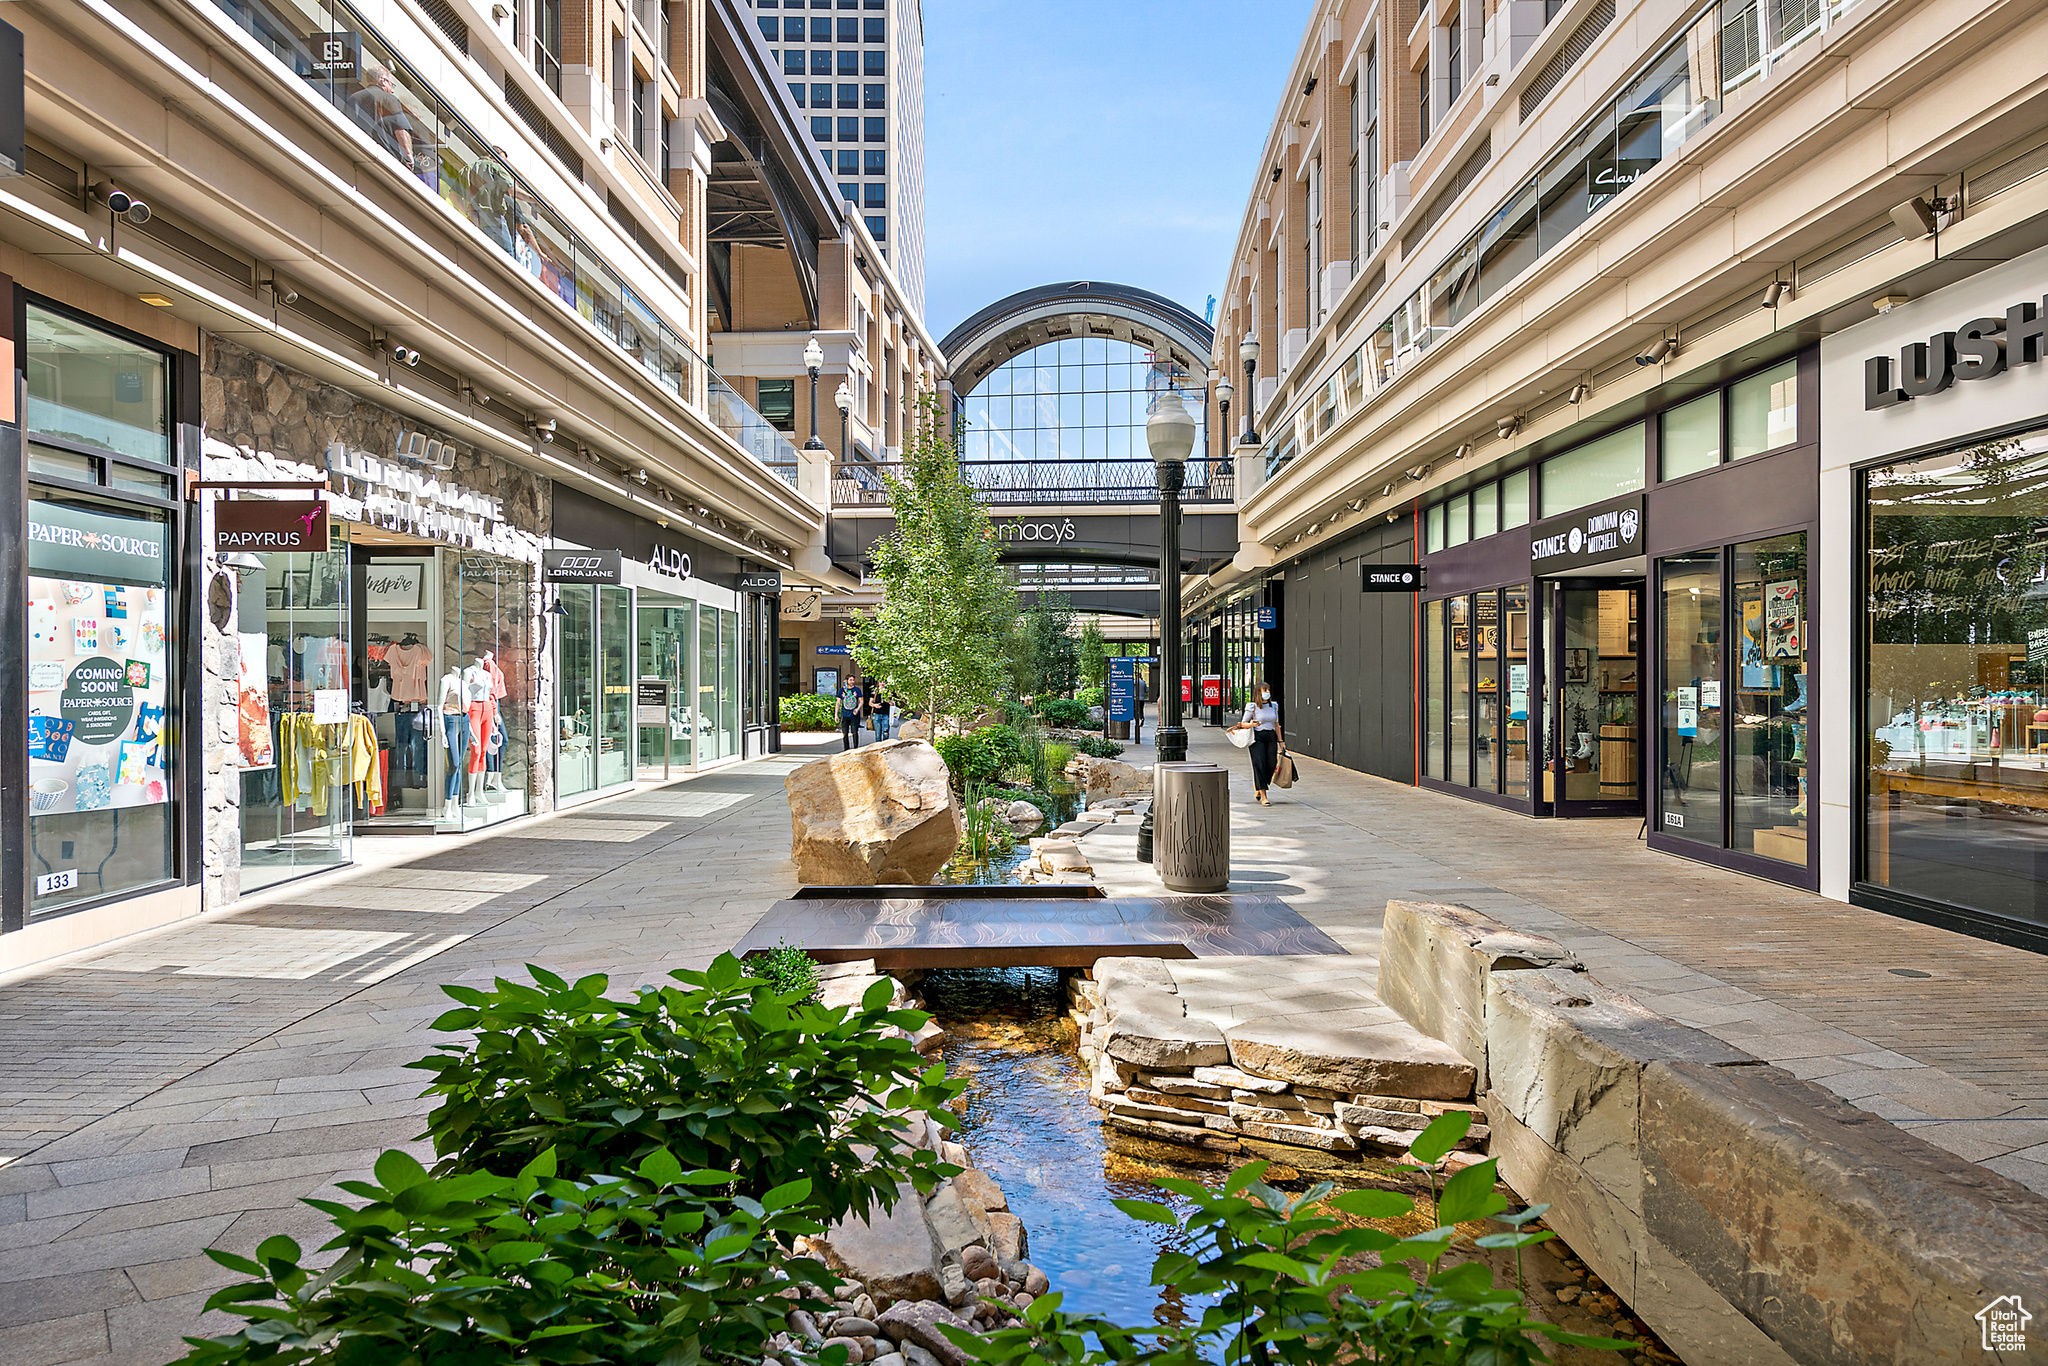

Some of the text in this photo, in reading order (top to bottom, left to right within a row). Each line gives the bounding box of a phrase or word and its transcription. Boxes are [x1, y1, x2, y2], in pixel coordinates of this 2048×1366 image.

[1864, 294, 2048, 411] LUSH
[331, 442, 505, 522] LORNA JANE
[999, 517, 1076, 545] macy's
[1587, 511, 1619, 534] DONOVAN
[27, 521, 160, 558] PAPER SOURCE
[217, 531, 301, 546] PAPYRUS
[1531, 533, 1567, 560] STANCE
[1587, 531, 1619, 554] MITCHELL
[650, 543, 692, 579] ALDO
[547, 569, 614, 578] LORNA JANE
[740, 578, 778, 587] ALDO
[1370, 573, 1401, 583] STANCE
[1924, 567, 1967, 592] WITH
[366, 574, 413, 594] Inspire
[75, 668, 123, 680] COMING
[80, 681, 119, 693] SOON!
[62, 696, 133, 708] PAPER SOURCE
[1665, 813, 1683, 828] 161A
[45, 874, 70, 890] 133
